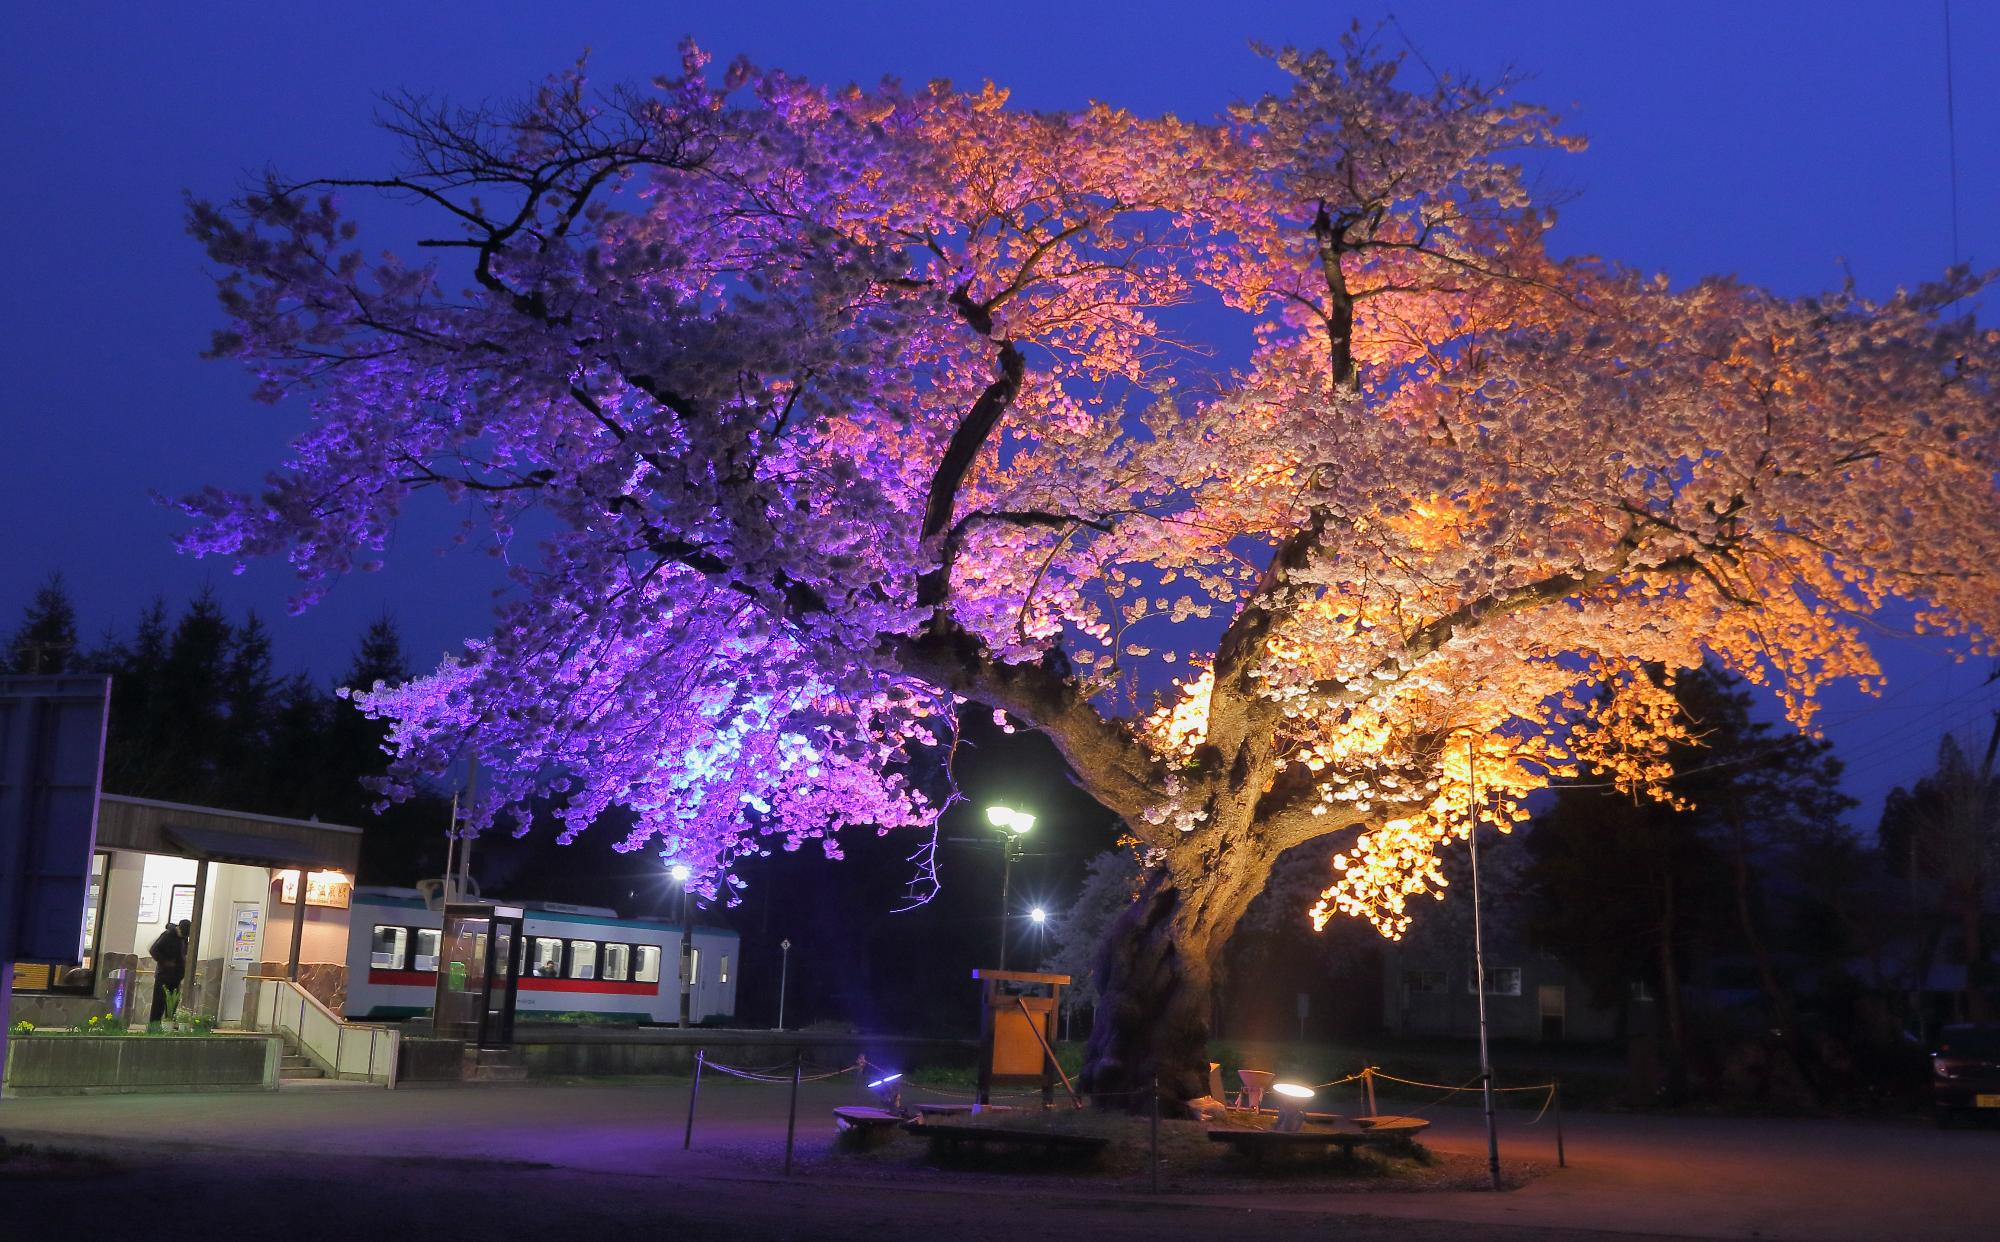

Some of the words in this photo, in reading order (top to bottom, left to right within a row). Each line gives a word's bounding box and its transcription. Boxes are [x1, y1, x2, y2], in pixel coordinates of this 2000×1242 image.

[285, 881, 347, 898] 中平温泉駅
